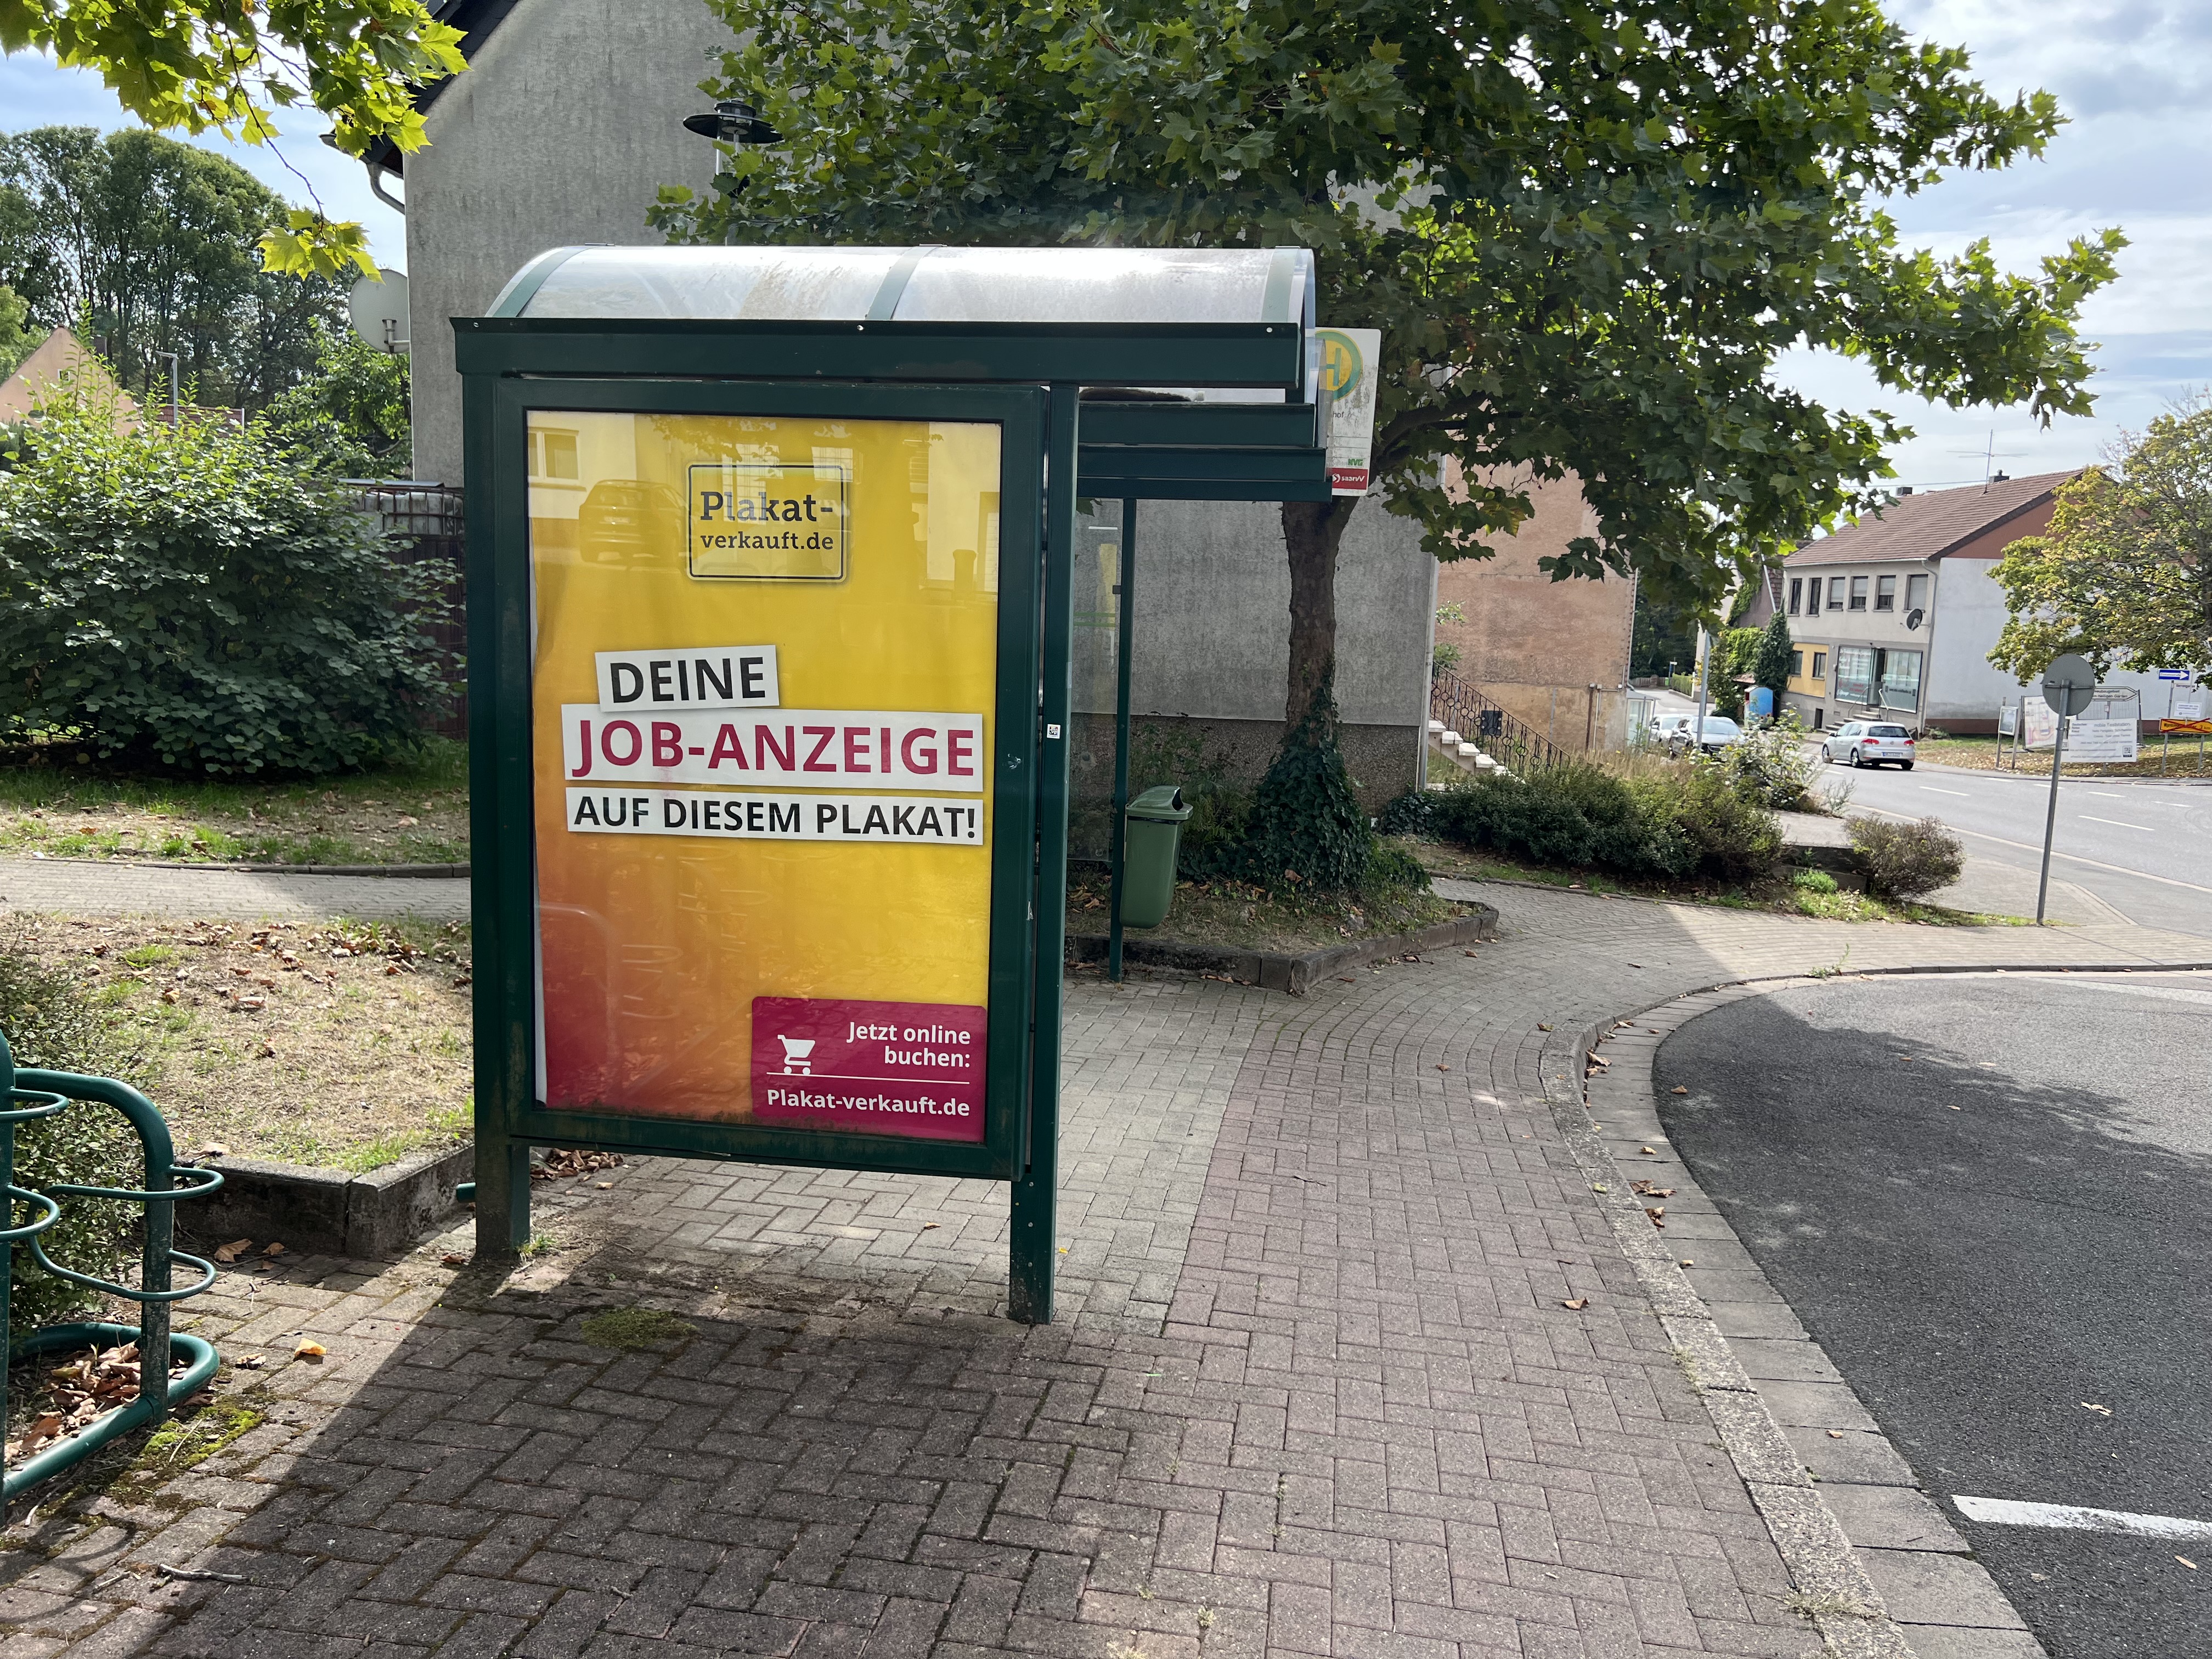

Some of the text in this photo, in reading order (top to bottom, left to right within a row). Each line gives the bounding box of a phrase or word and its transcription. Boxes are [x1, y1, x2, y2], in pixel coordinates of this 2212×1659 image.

[700, 490, 833, 522] Plakat-
[700, 532, 834, 550] verkauft.de
[610, 657, 766, 703] DEINE
[572, 719, 974, 777] JOB-ANZEIGE
[574, 796, 976, 839] AUF DIESEM PLAKAT!
[847, 1022, 970, 1044] Jetzt online
[884, 1046, 970, 1068] buchen:
[766, 1089, 970, 1116] Plakat-verkauft.de
